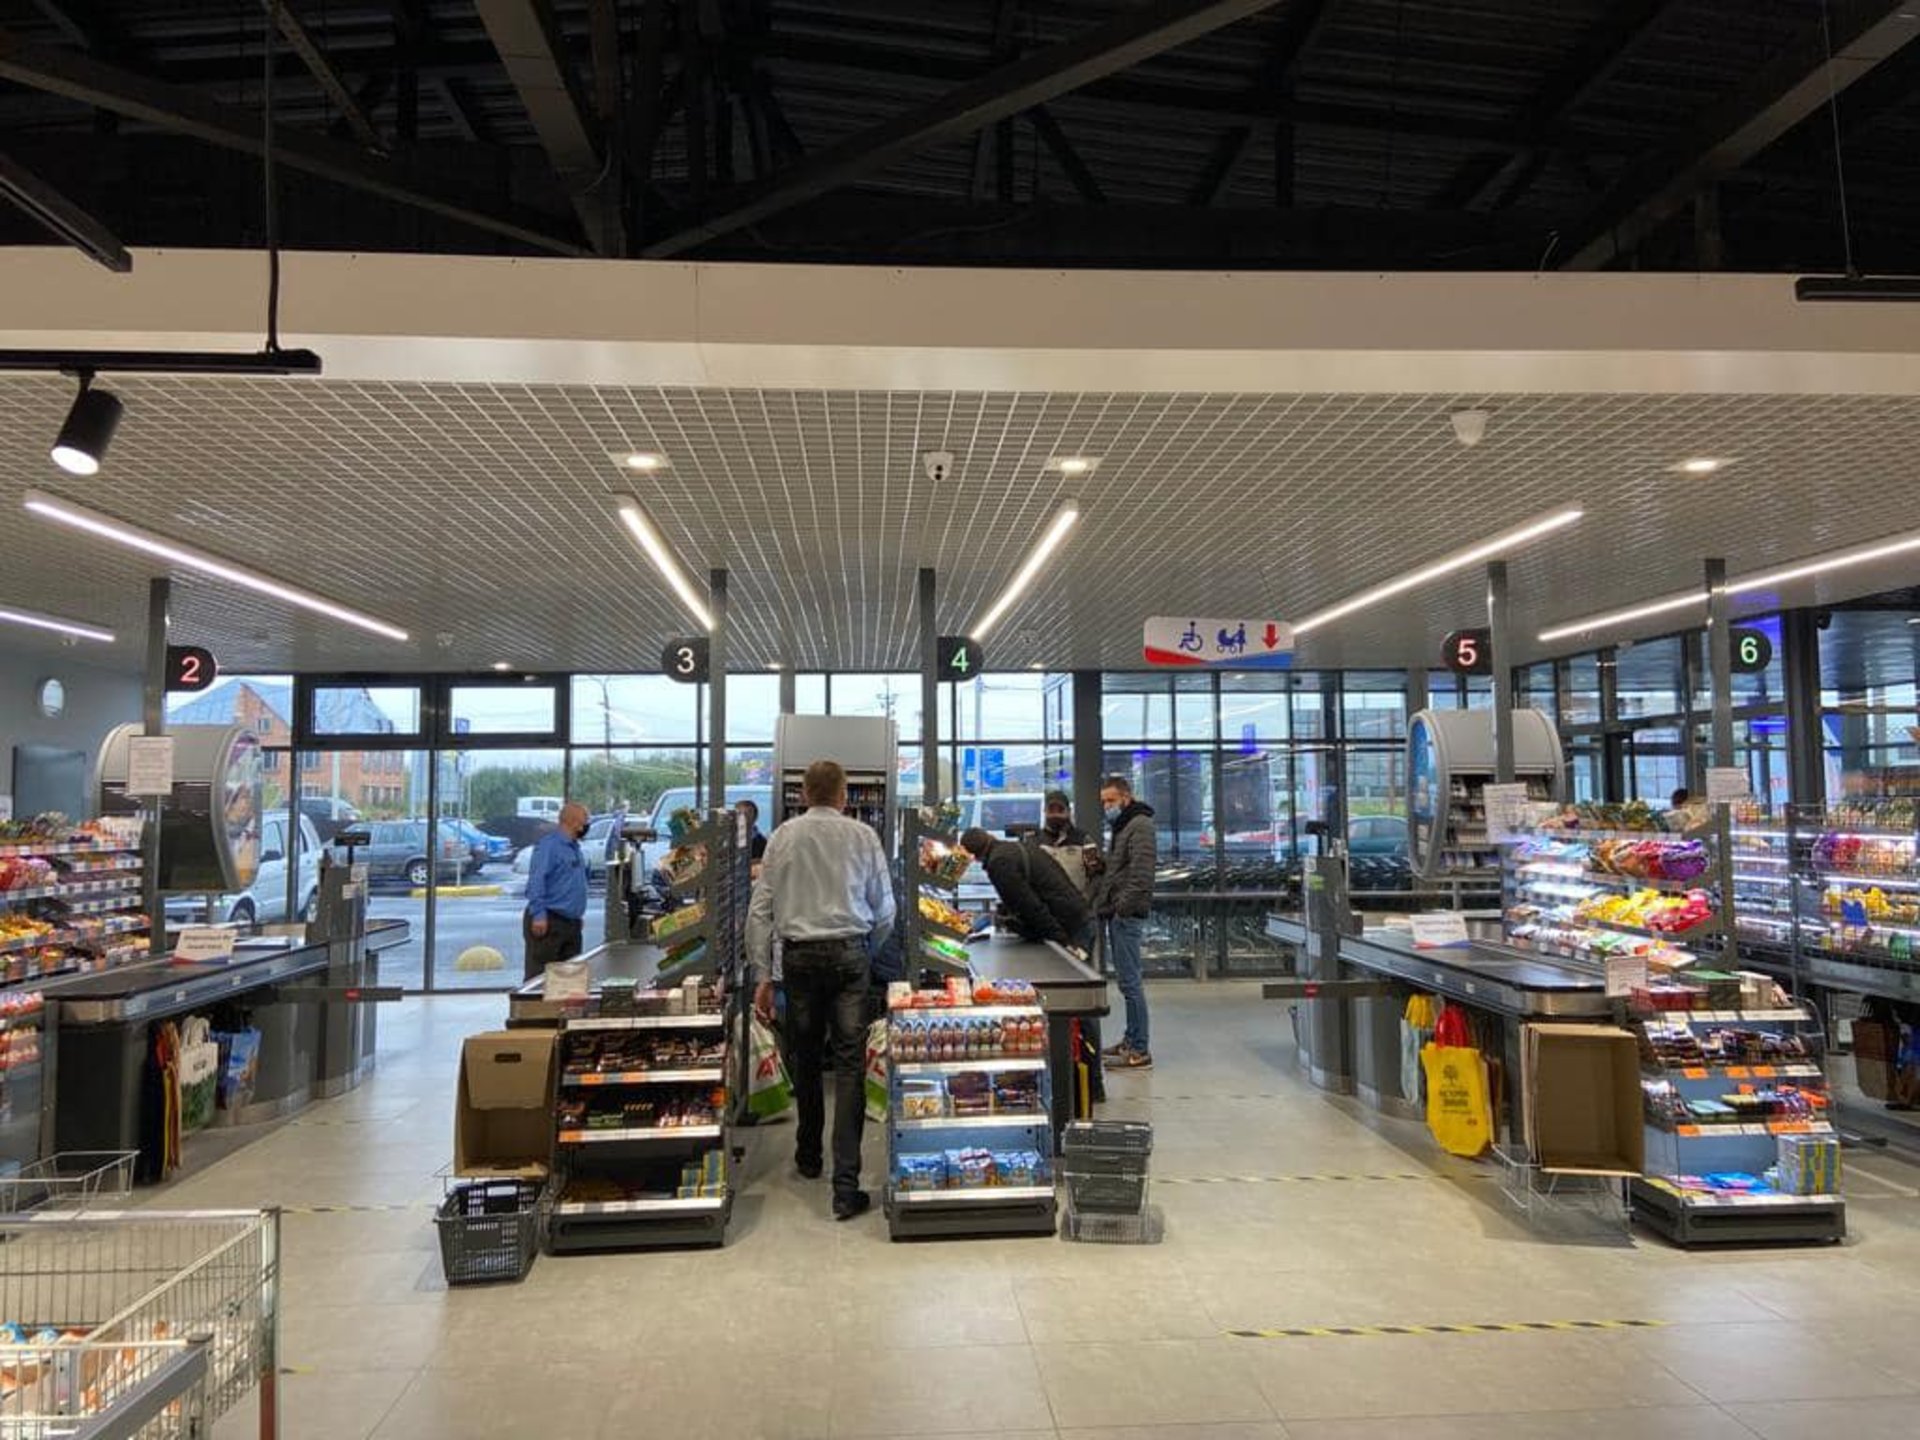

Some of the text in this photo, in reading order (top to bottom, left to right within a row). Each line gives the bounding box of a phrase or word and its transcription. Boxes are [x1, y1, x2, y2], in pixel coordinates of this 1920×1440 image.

[676, 646, 695, 673] 3
[951, 646, 970, 673] 4
[1457, 638, 1477, 666] 5
[1740, 636, 1758, 663] 6
[180, 656, 200, 682] 2
